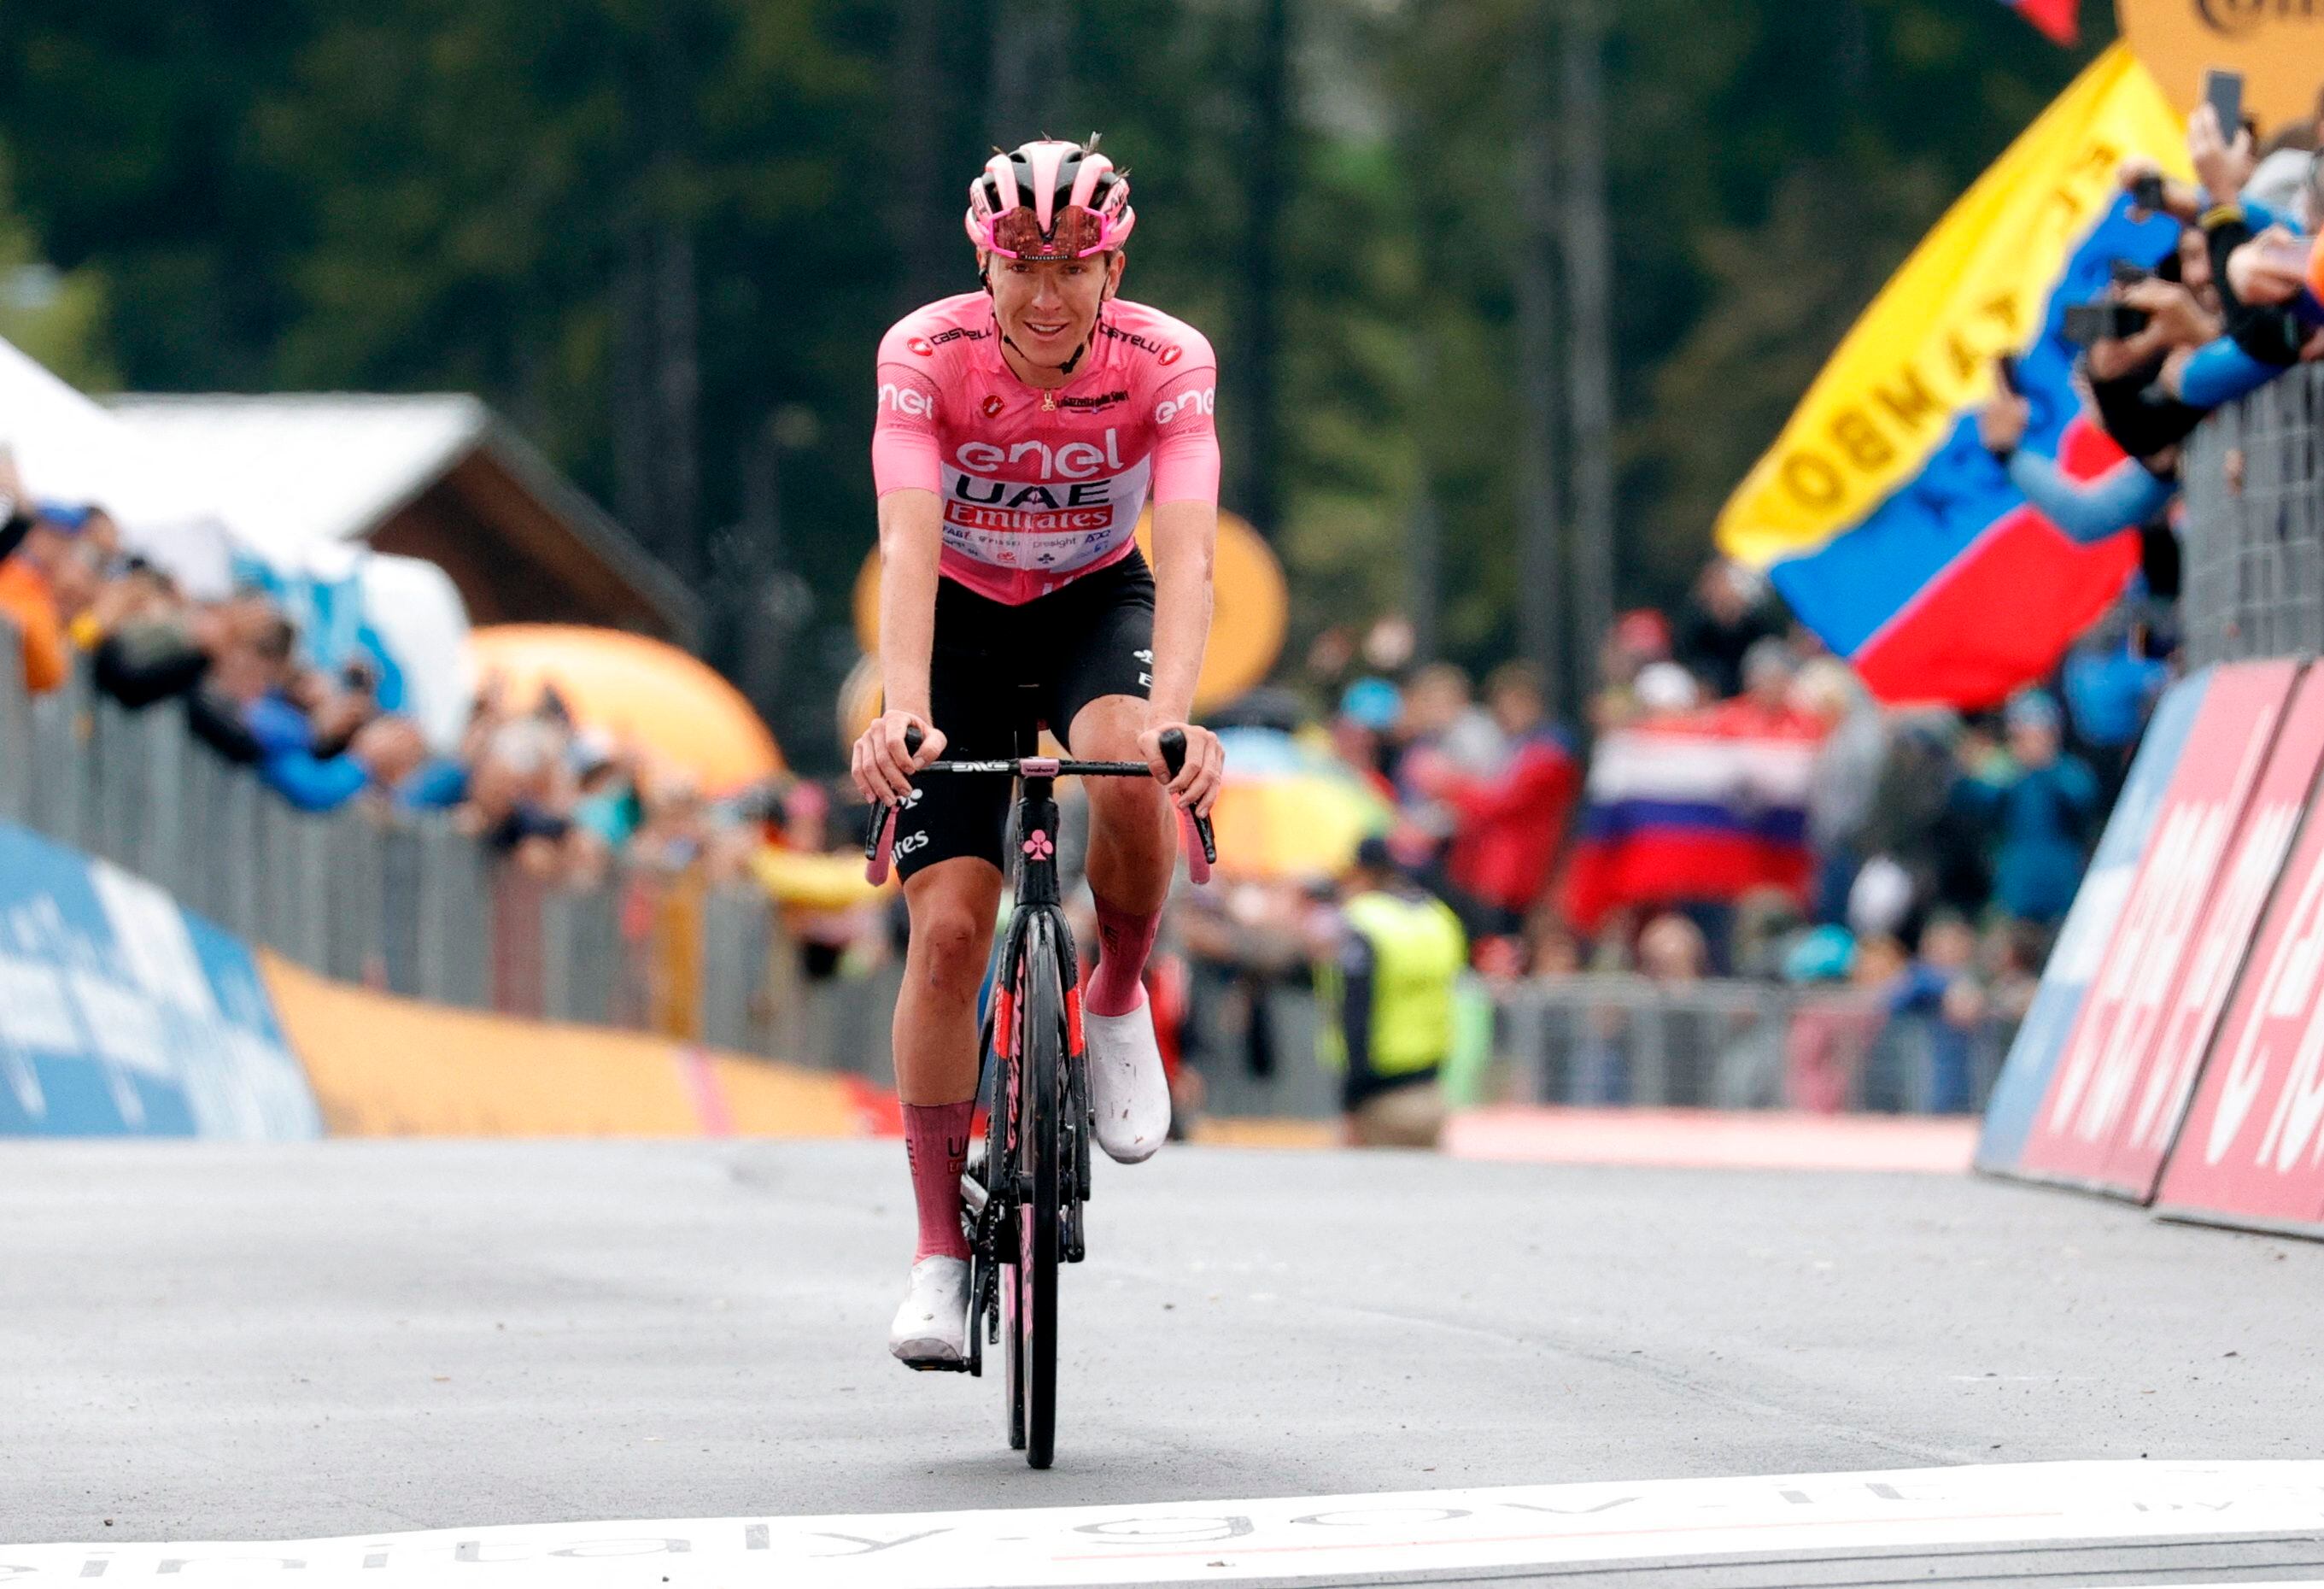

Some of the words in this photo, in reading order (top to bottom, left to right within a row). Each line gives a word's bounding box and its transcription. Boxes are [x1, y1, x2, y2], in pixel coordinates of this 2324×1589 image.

[877, 383, 934, 421] nel
[1156, 387, 1214, 425] en
[956, 428, 1125, 480] enel
[955, 473, 1111, 509] UAE
[950, 502, 1109, 531] Emirates
[891, 830, 929, 866] tes
